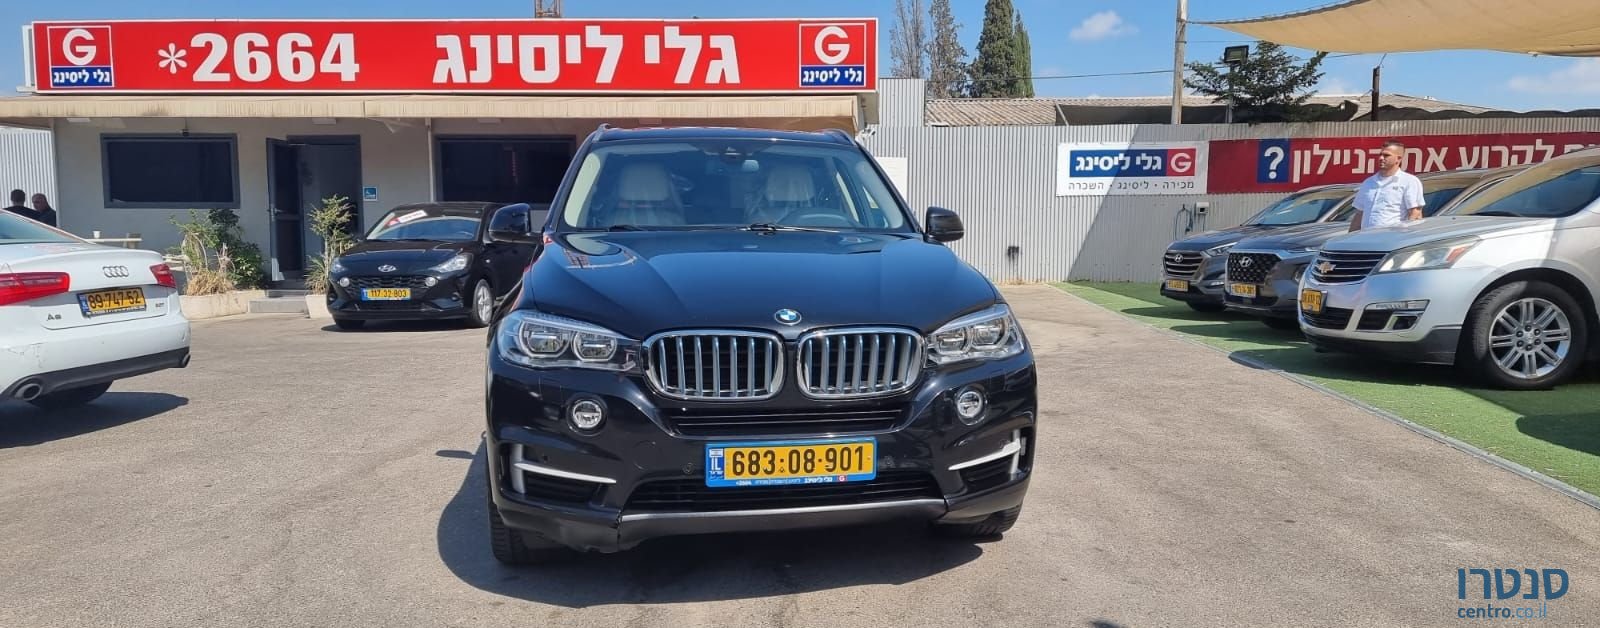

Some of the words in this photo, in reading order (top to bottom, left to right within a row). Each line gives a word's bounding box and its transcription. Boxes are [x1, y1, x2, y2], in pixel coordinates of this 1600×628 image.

[62, 28, 97, 66] G
[814, 25, 850, 65] G
[432, 25, 624, 84] ליסינג
[644, 25, 741, 84] גלי
[53, 69, 90, 83] ליסינג
[92, 69, 111, 83] גלי
[802, 67, 840, 83] ליסינג
[844, 67, 862, 82] גלי
[1075, 153, 1131, 171] ליסינג
[1135, 153, 1162, 171] גלי
[1170, 152, 1192, 173] G
[1401, 146, 1448, 173] את
[1068, 182, 1104, 190] השכרה
[1117, 180, 1149, 190] ליסינג
[1162, 181, 1194, 189] מכירה
